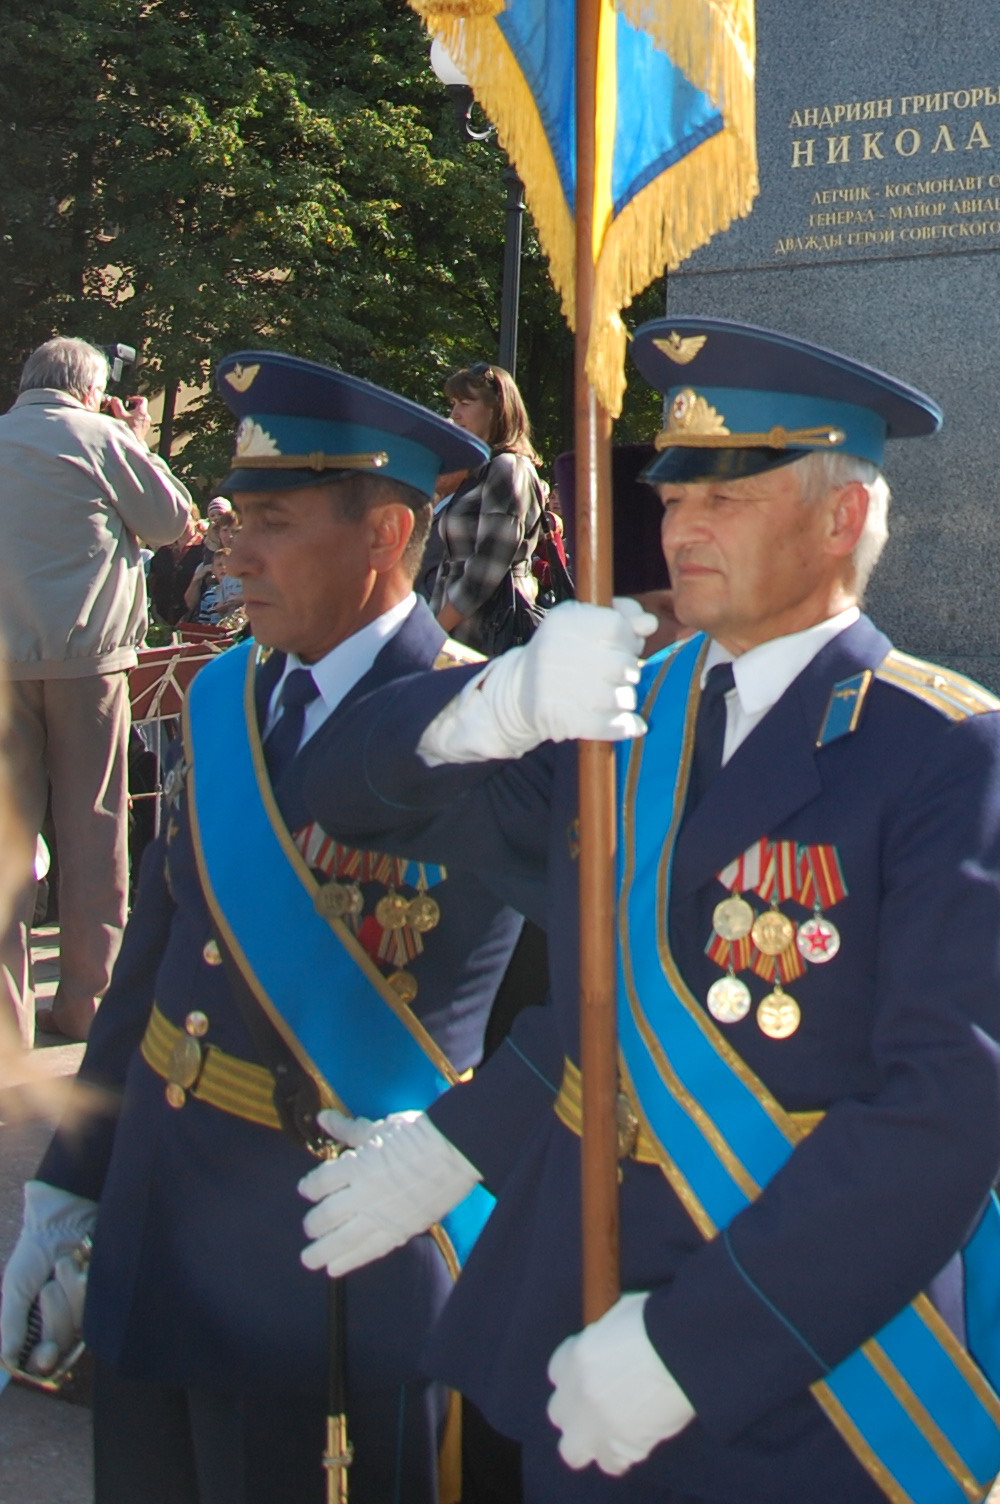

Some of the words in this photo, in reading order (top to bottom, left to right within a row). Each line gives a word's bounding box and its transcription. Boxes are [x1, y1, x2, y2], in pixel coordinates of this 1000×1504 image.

[788, 98, 893, 129] АНДРИЯН
[811, 186, 871, 205] ЛЕТЧИК
[884, 175, 985, 198] КОСМОНАВТ
[808, 208, 875, 228] ГЕНЕРАЛ
[889, 200, 947, 220] МАЙОР
[774, 233, 842, 255] ДВАЖДЫ
[848, 228, 895, 246] ГЕРОЙ
